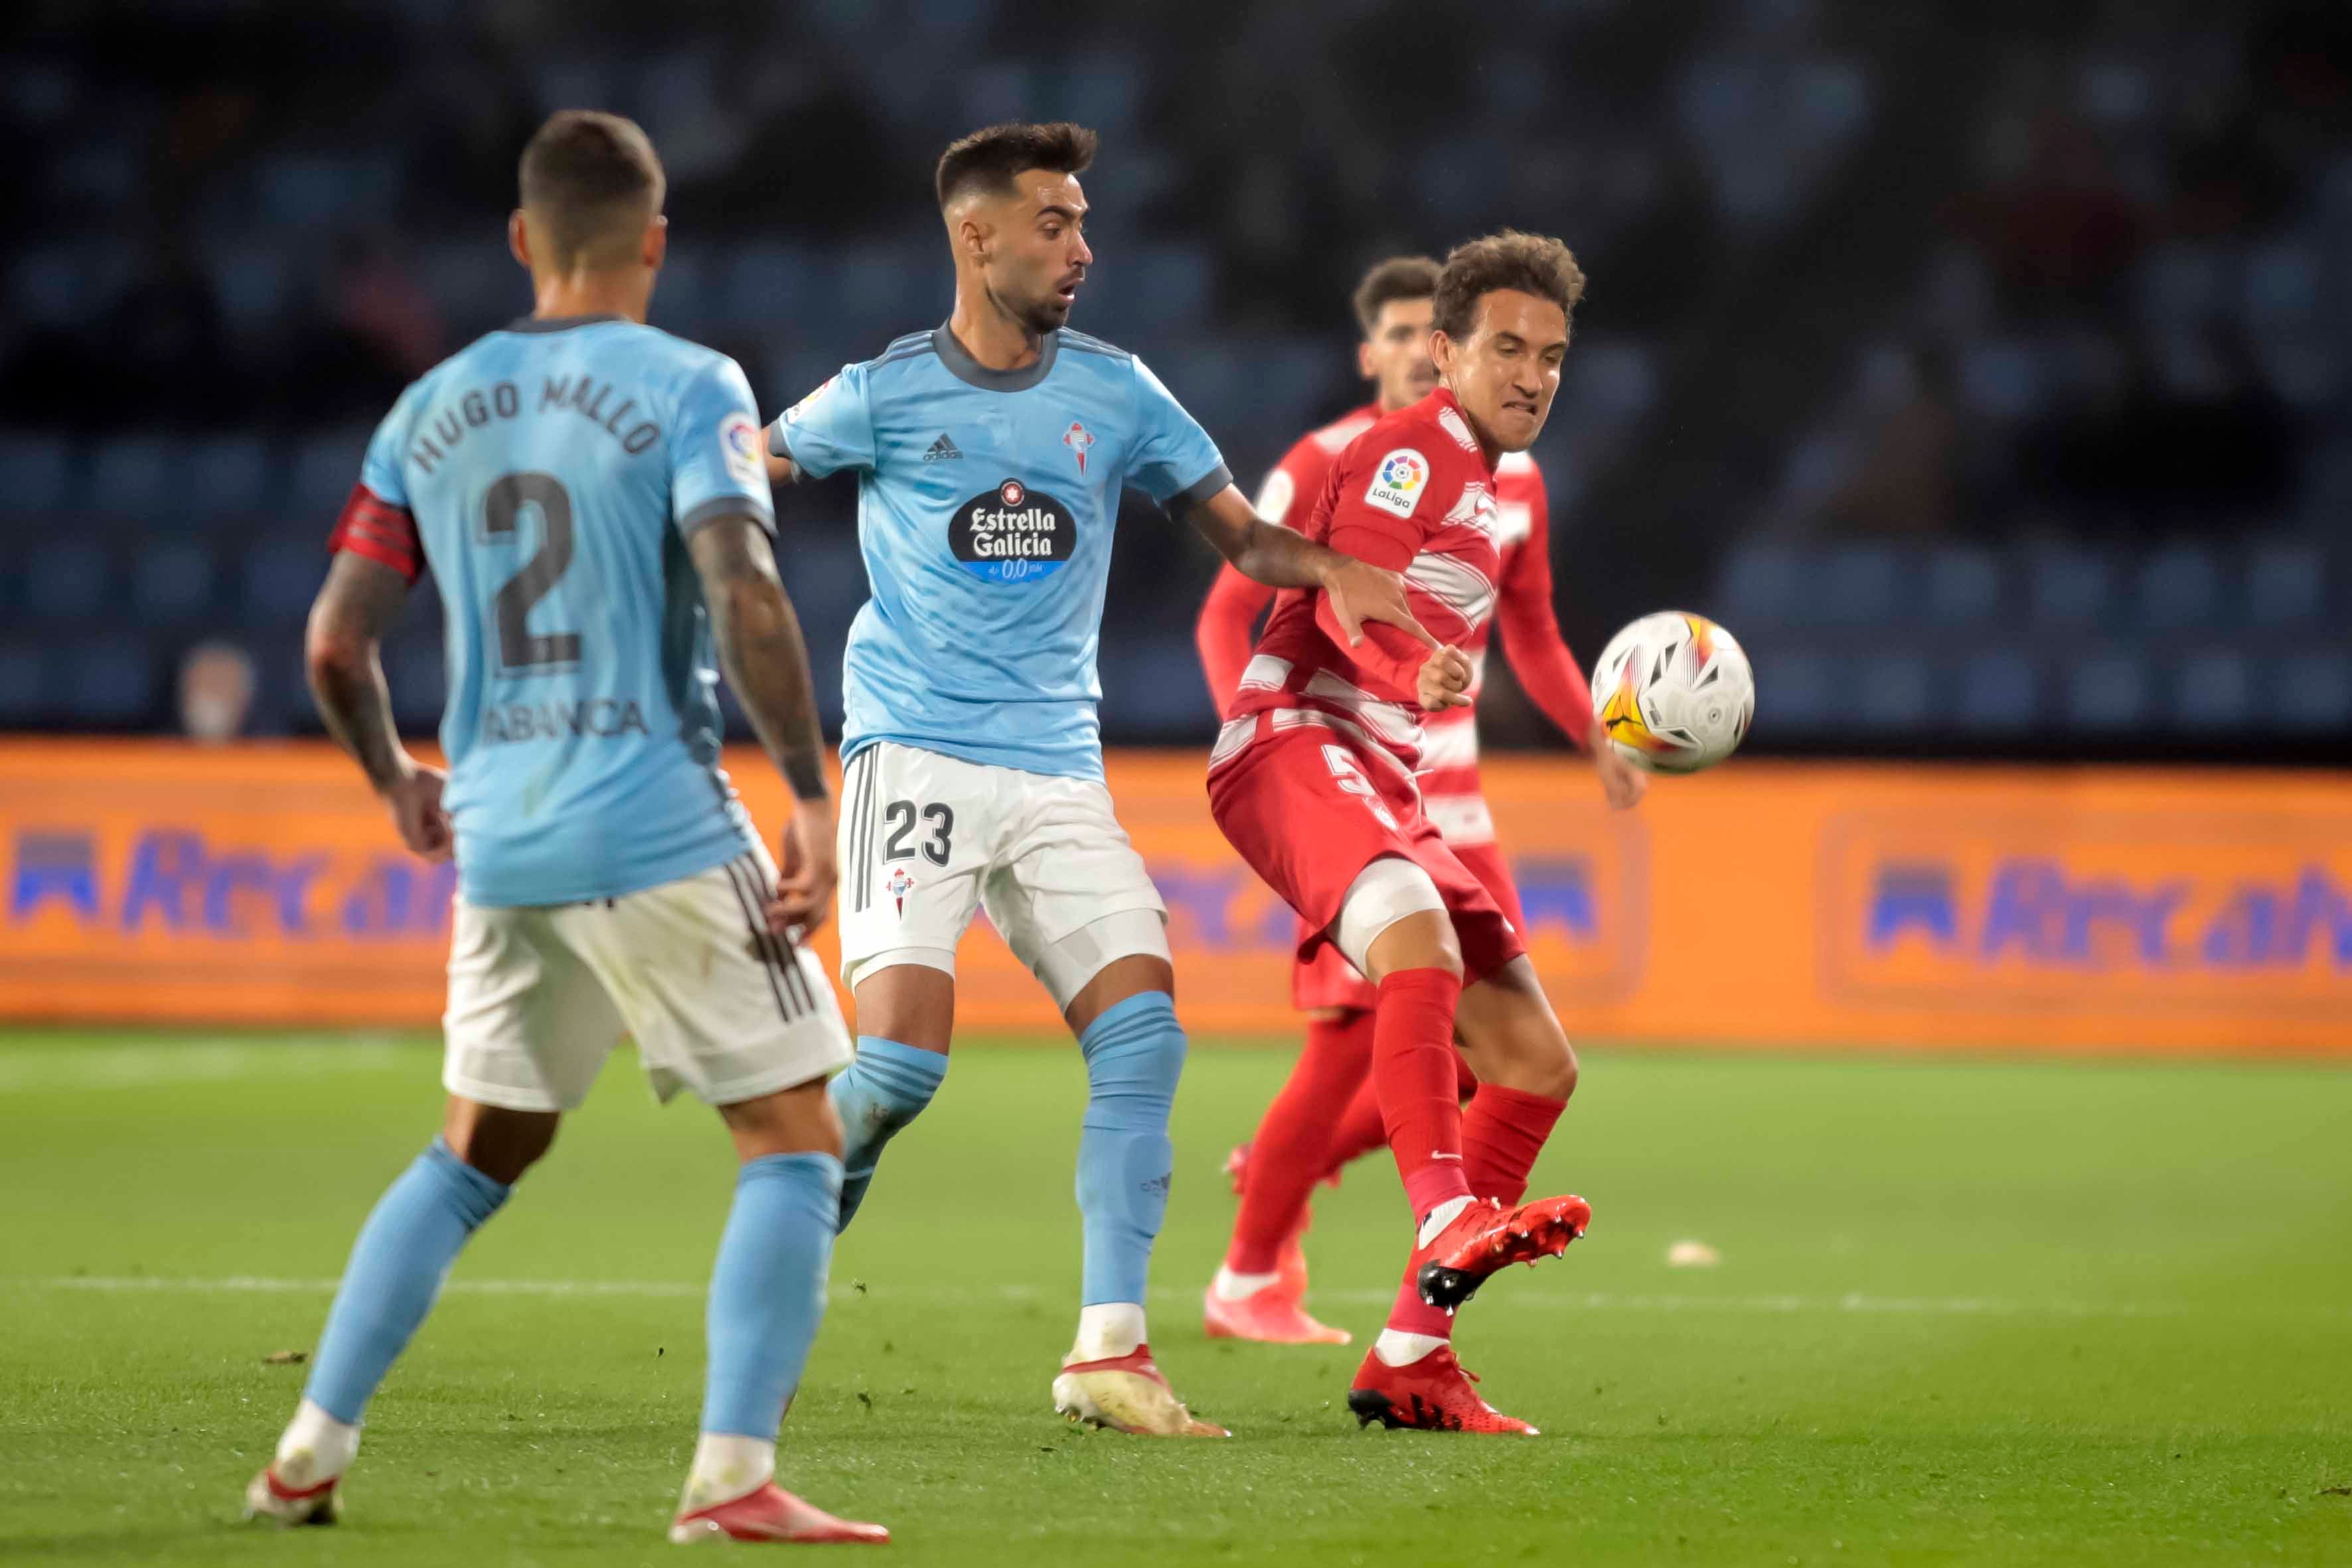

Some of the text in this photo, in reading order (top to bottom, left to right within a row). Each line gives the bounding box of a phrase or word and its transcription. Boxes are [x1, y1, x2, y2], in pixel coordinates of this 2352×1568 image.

[410, 374, 662, 475] HUGO MALLO
[969, 508, 1056, 531] Estrella
[1373, 488, 1410, 509] LaLiga
[974, 532, 1052, 556] Galicia
[479, 471, 582, 672] 2
[483, 699, 649, 745] ABANCA
[1320, 744, 1375, 796] 5
[883, 800, 954, 866] 23
